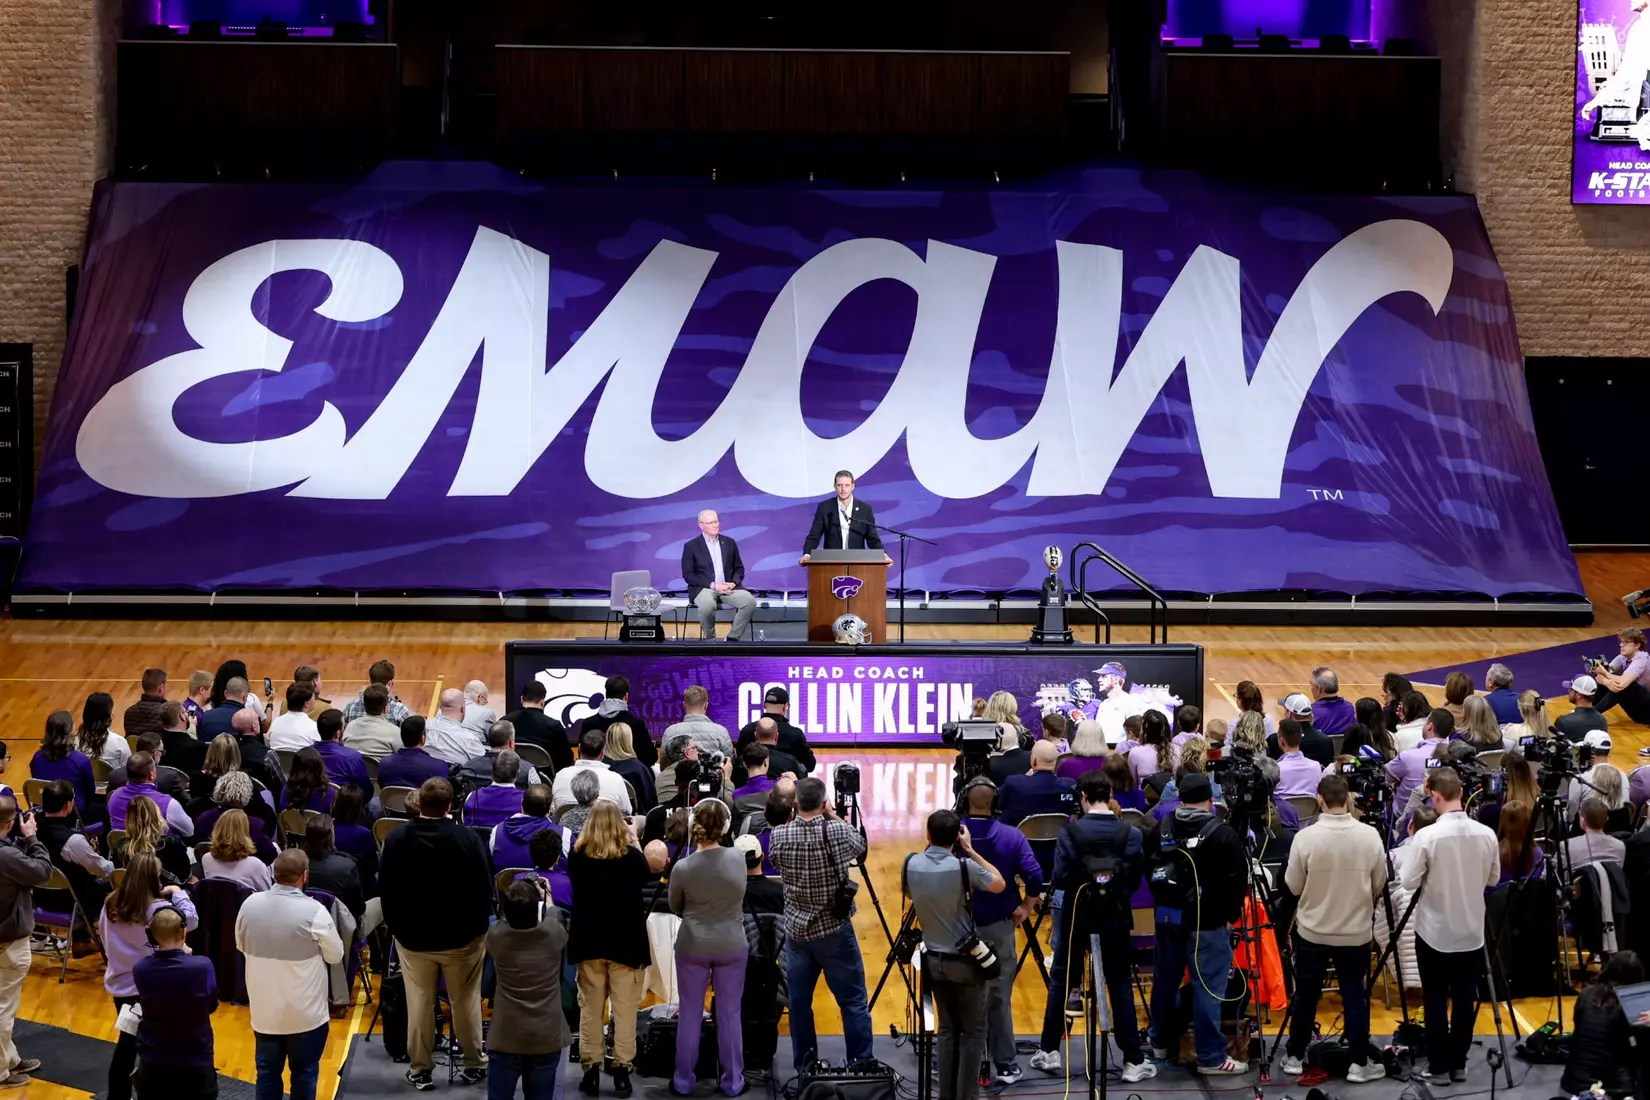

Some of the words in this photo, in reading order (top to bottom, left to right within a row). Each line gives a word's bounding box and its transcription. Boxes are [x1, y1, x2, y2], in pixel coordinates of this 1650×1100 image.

[1306, 489, 1344, 500] TM
[788, 666, 844, 679] HEAD
[854, 666, 924, 679] COACH
[738, 682, 862, 734] CLLIN
[873, 682, 973, 734] KLEIN
